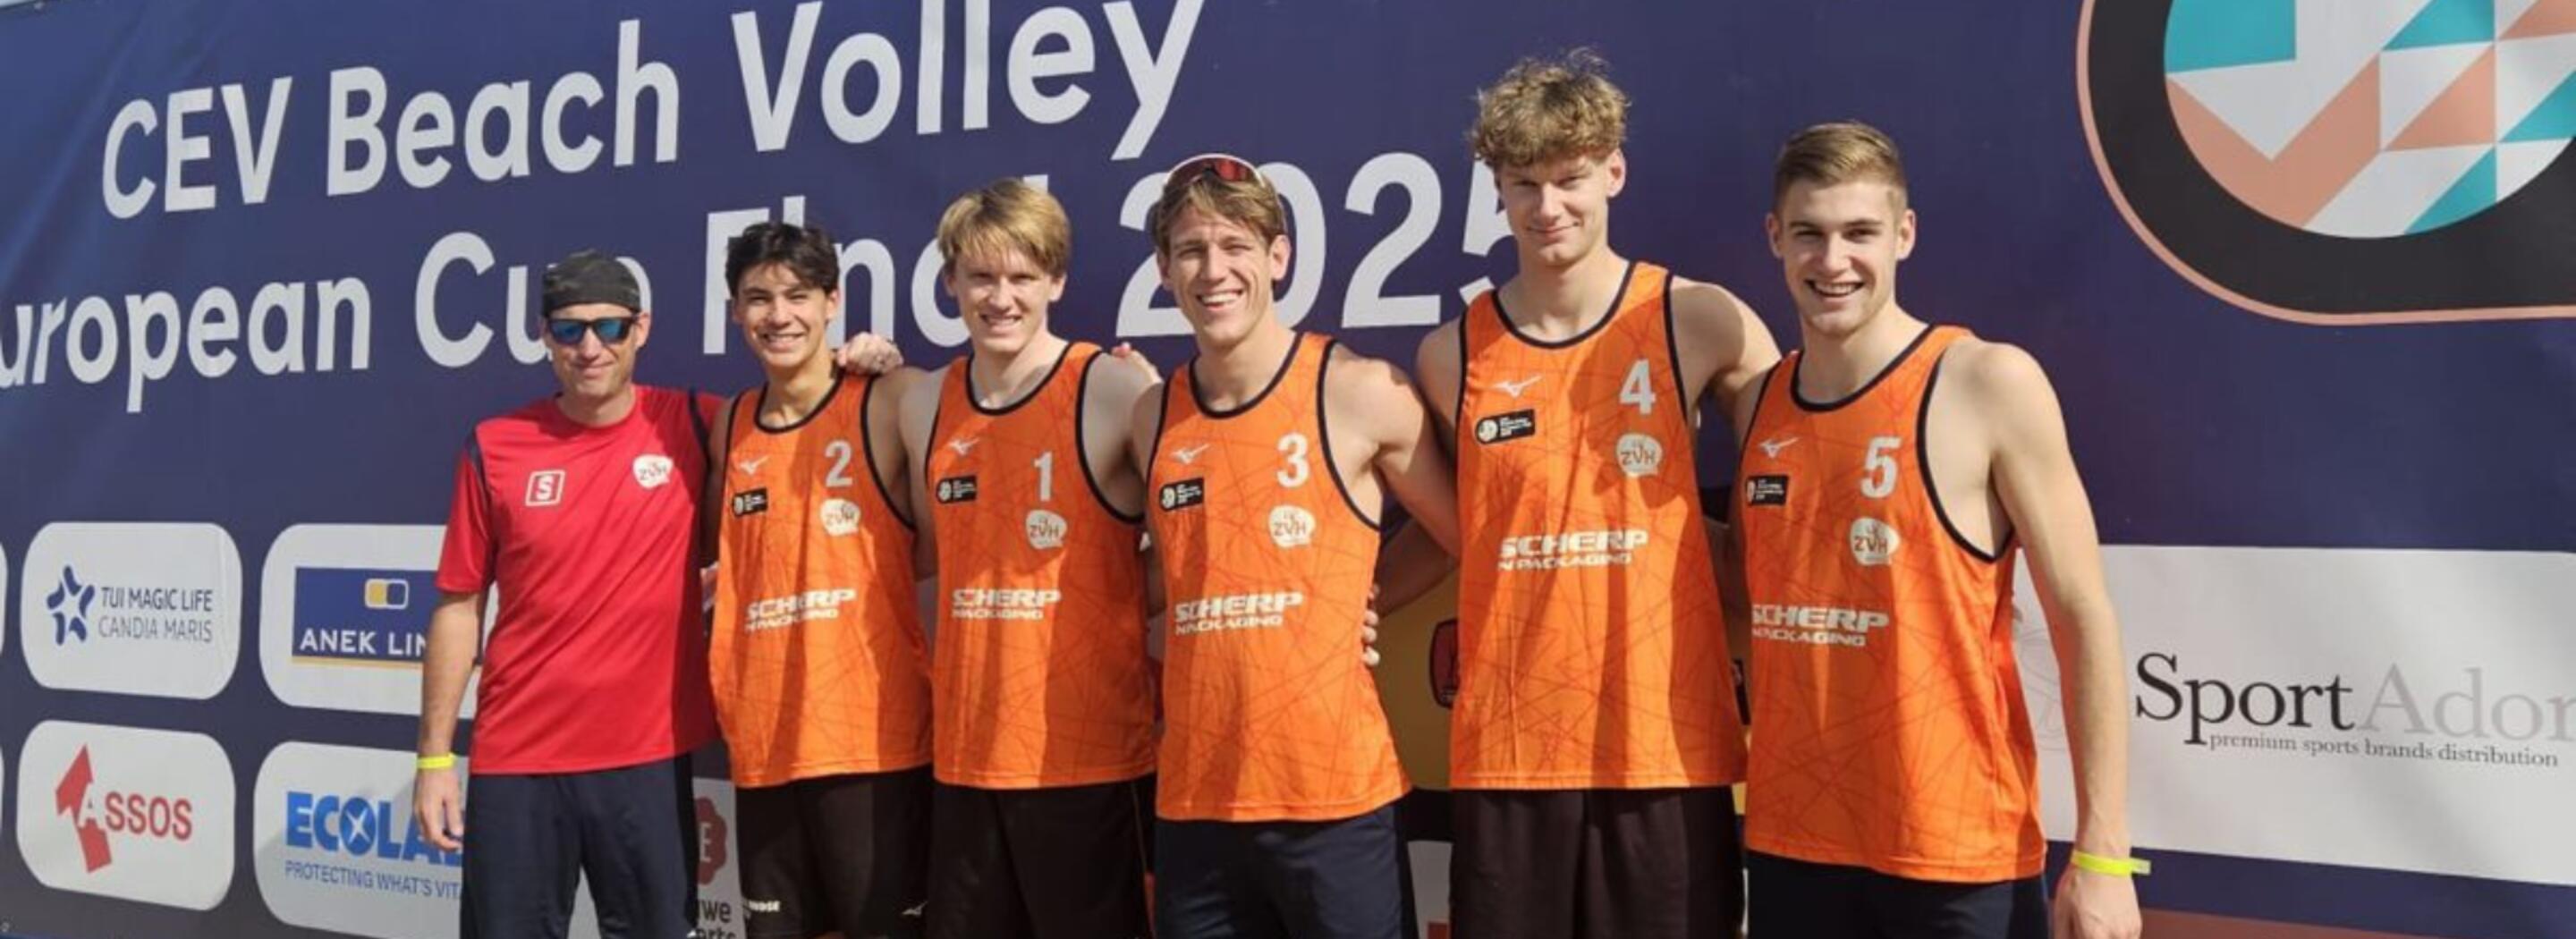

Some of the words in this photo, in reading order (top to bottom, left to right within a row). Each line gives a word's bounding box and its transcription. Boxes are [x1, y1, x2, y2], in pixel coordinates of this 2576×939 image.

[102, 76, 293, 220] CEV
[326, 19, 680, 197] Beach
[730, 0, 1203, 161] Volley
[415, 232, 652, 368] Cu
[1619, 359, 1657, 415] 4
[825, 440, 853, 487] 2
[1034, 451, 1053, 502] 1
[1276, 432, 1309, 488] 3
[1860, 436, 1902, 498] 5
[536, 475, 555, 502] S
[1500, 529, 1649, 558] SCHERP
[1853, 535, 1888, 554] ZVH
[101, 587, 124, 608] TUI
[128, 588, 178, 611] MAGIC
[97, 615, 157, 639] CANDIA
[164, 619, 213, 643] MARIS
[300, 628, 377, 655] ANEK
[2209, 732, 2298, 750] premium
[2302, 738, 2360, 757] sports
[2366, 738, 2433, 758] brands
[2438, 743, 2559, 766] distribution
[284, 859, 373, 889] PROTECTING
[376, 871, 433, 898] WHAT'S
[435, 881, 462, 900] VIT
